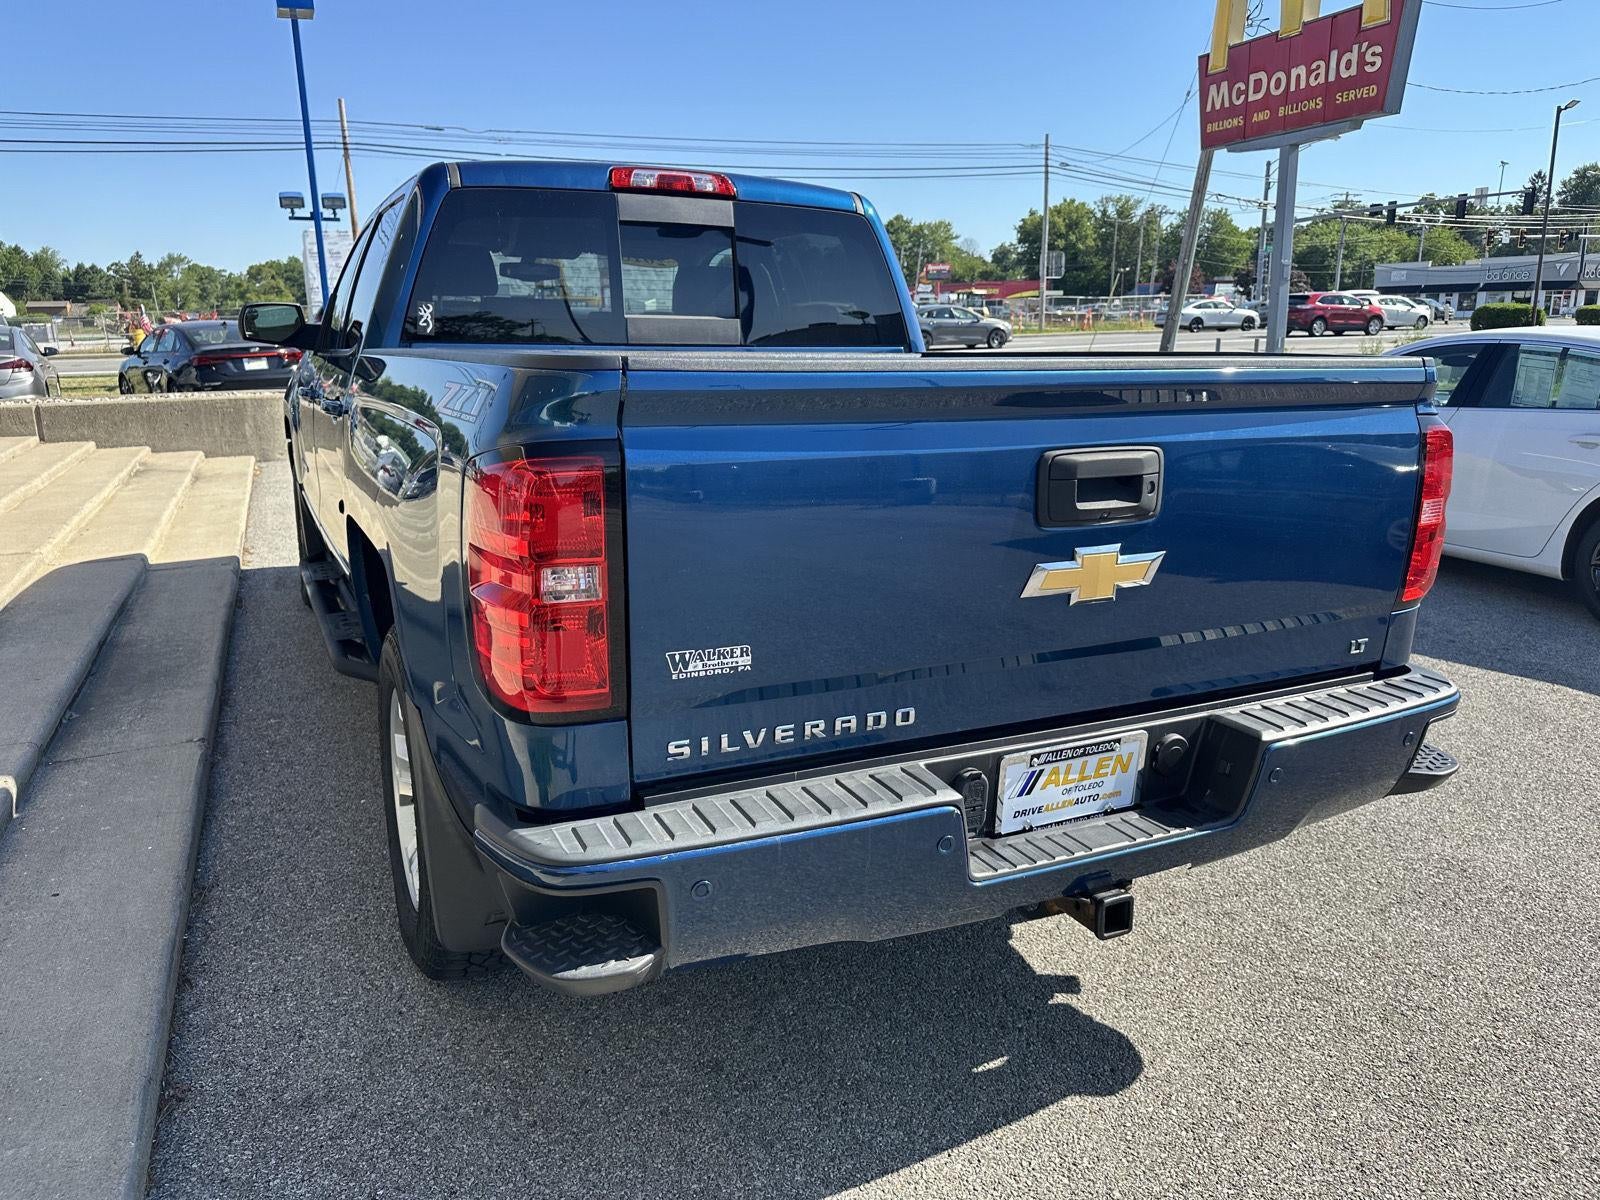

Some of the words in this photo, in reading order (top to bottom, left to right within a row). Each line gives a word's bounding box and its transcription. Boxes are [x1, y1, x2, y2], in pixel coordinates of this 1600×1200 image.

[1206, 41, 1383, 112] McDonald's
[1206, 115, 1244, 133] BILLIONS
[1252, 110, 1271, 123] AND
[1278, 97, 1323, 116] BILLIONS
[1335, 85, 1378, 104] SERVED
[1486, 265, 1530, 280] balance
[1350, 637, 1369, 654] LT
[665, 644, 752, 673] WALKER
[702, 660, 739, 669] Brothers
[671, 667, 734, 680] EDINBORO,
[667, 706, 916, 762] SILVERADO
[1045, 748, 1074, 763] ALLEN
[1073, 746, 1083, 757] OF
[1085, 741, 1115, 755] TOLEDO
[1040, 752, 1134, 790] ALLEN
[1061, 785, 1074, 796] OF
[1074, 780, 1104, 793] TOLEDO
